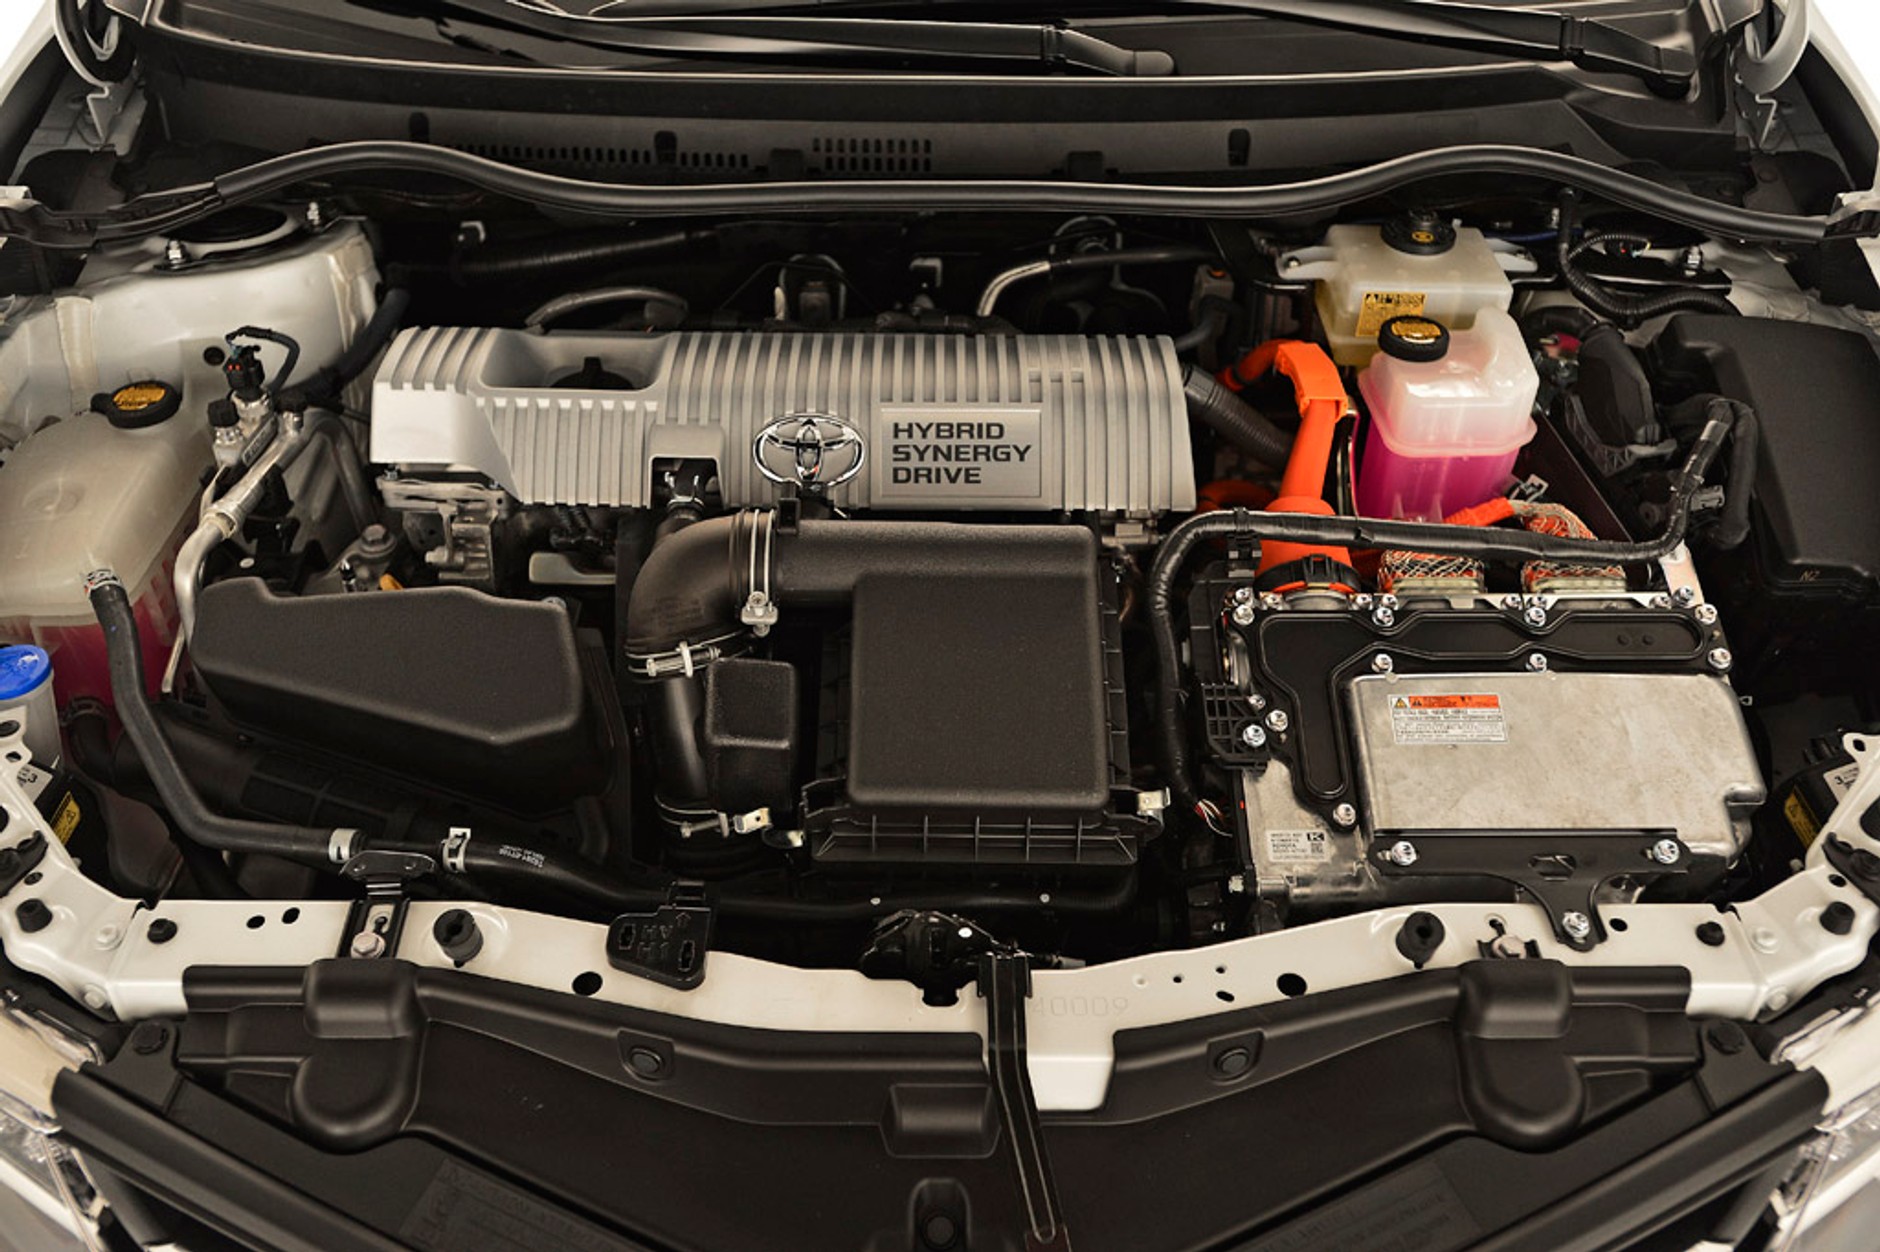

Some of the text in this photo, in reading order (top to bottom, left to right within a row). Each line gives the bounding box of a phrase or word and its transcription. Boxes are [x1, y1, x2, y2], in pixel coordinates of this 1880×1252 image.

[893, 422, 1004, 439] HYBRID
[892, 444, 1032, 462] SYNERGY
[892, 466, 982, 484] DRIVE
